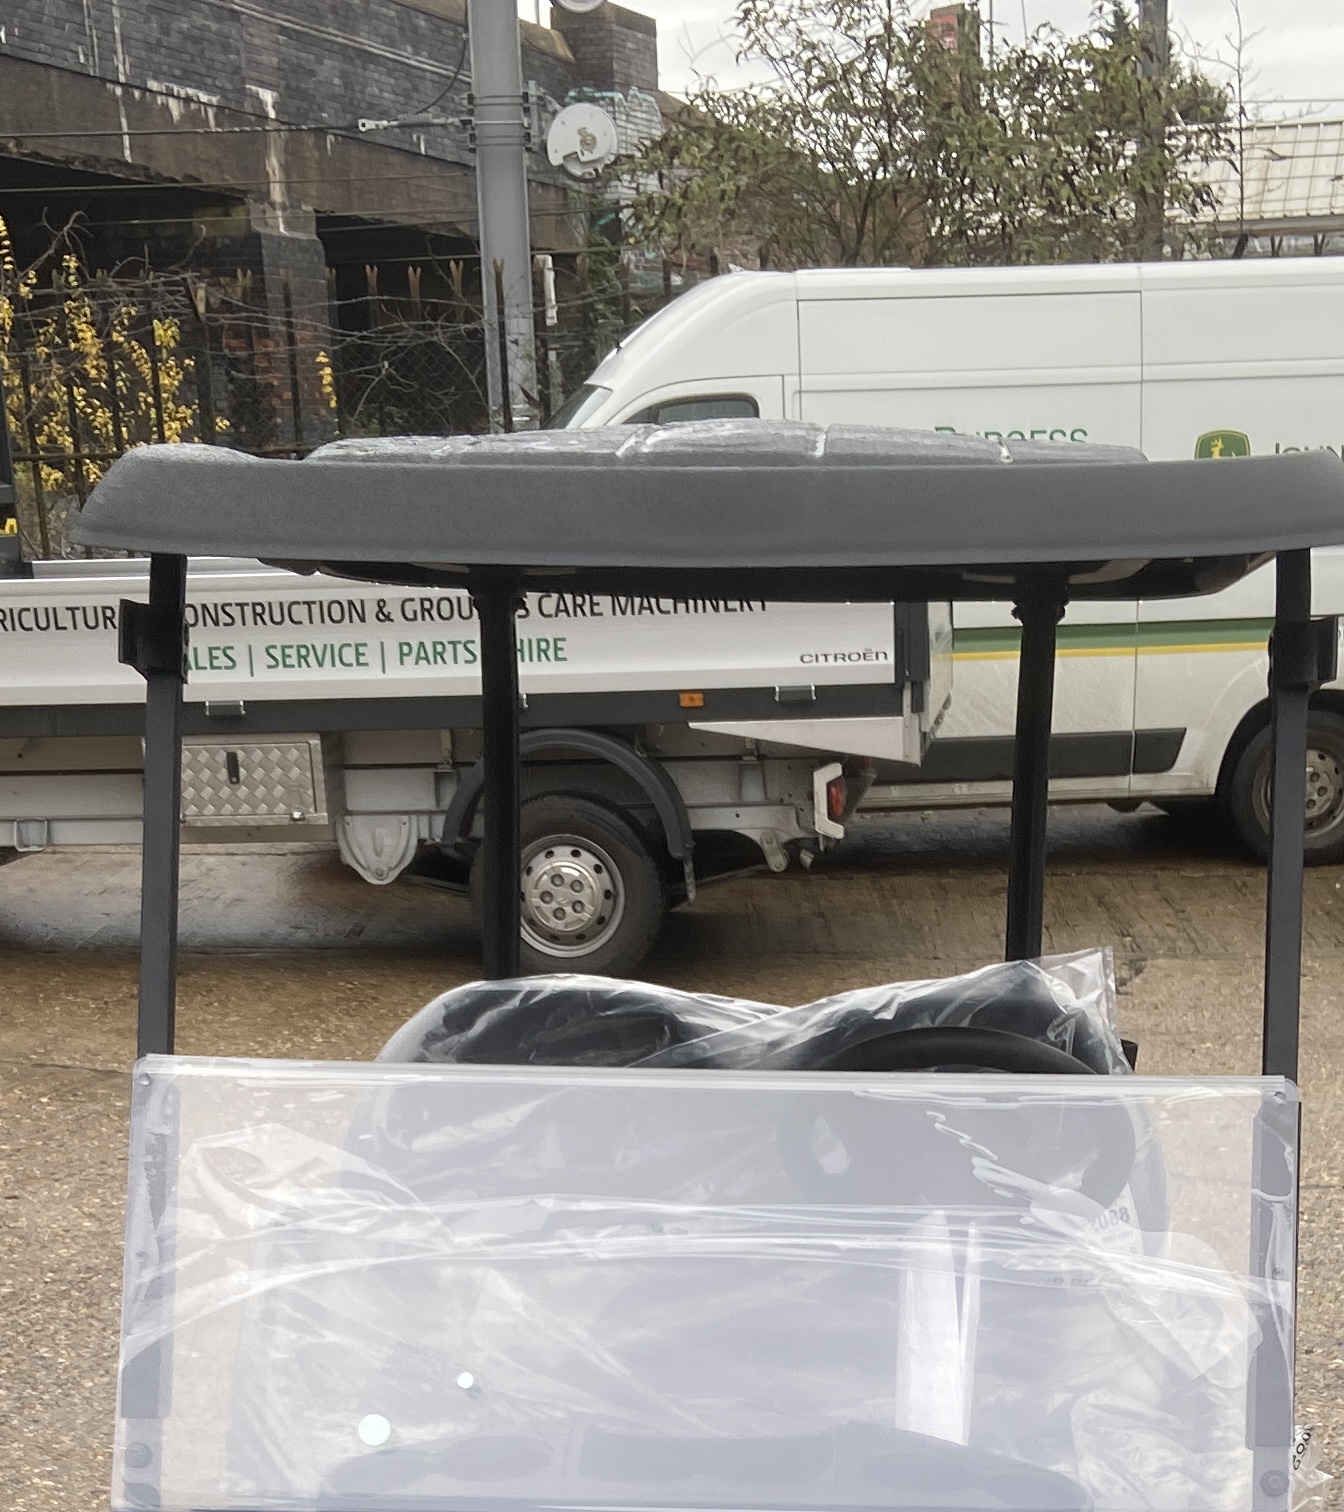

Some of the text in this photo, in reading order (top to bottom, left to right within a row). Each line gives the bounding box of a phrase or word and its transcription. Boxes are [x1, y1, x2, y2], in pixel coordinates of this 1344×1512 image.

[184, 599, 367, 628] ONSTRUCTION
[375, 598, 395, 624] &
[402, 596, 531, 623] GROUS
[538, 593, 604, 618] CARE
[189, 646, 237, 671] LES
[265, 642, 370, 670] SERVICE
[398, 639, 478, 666] PARTS
